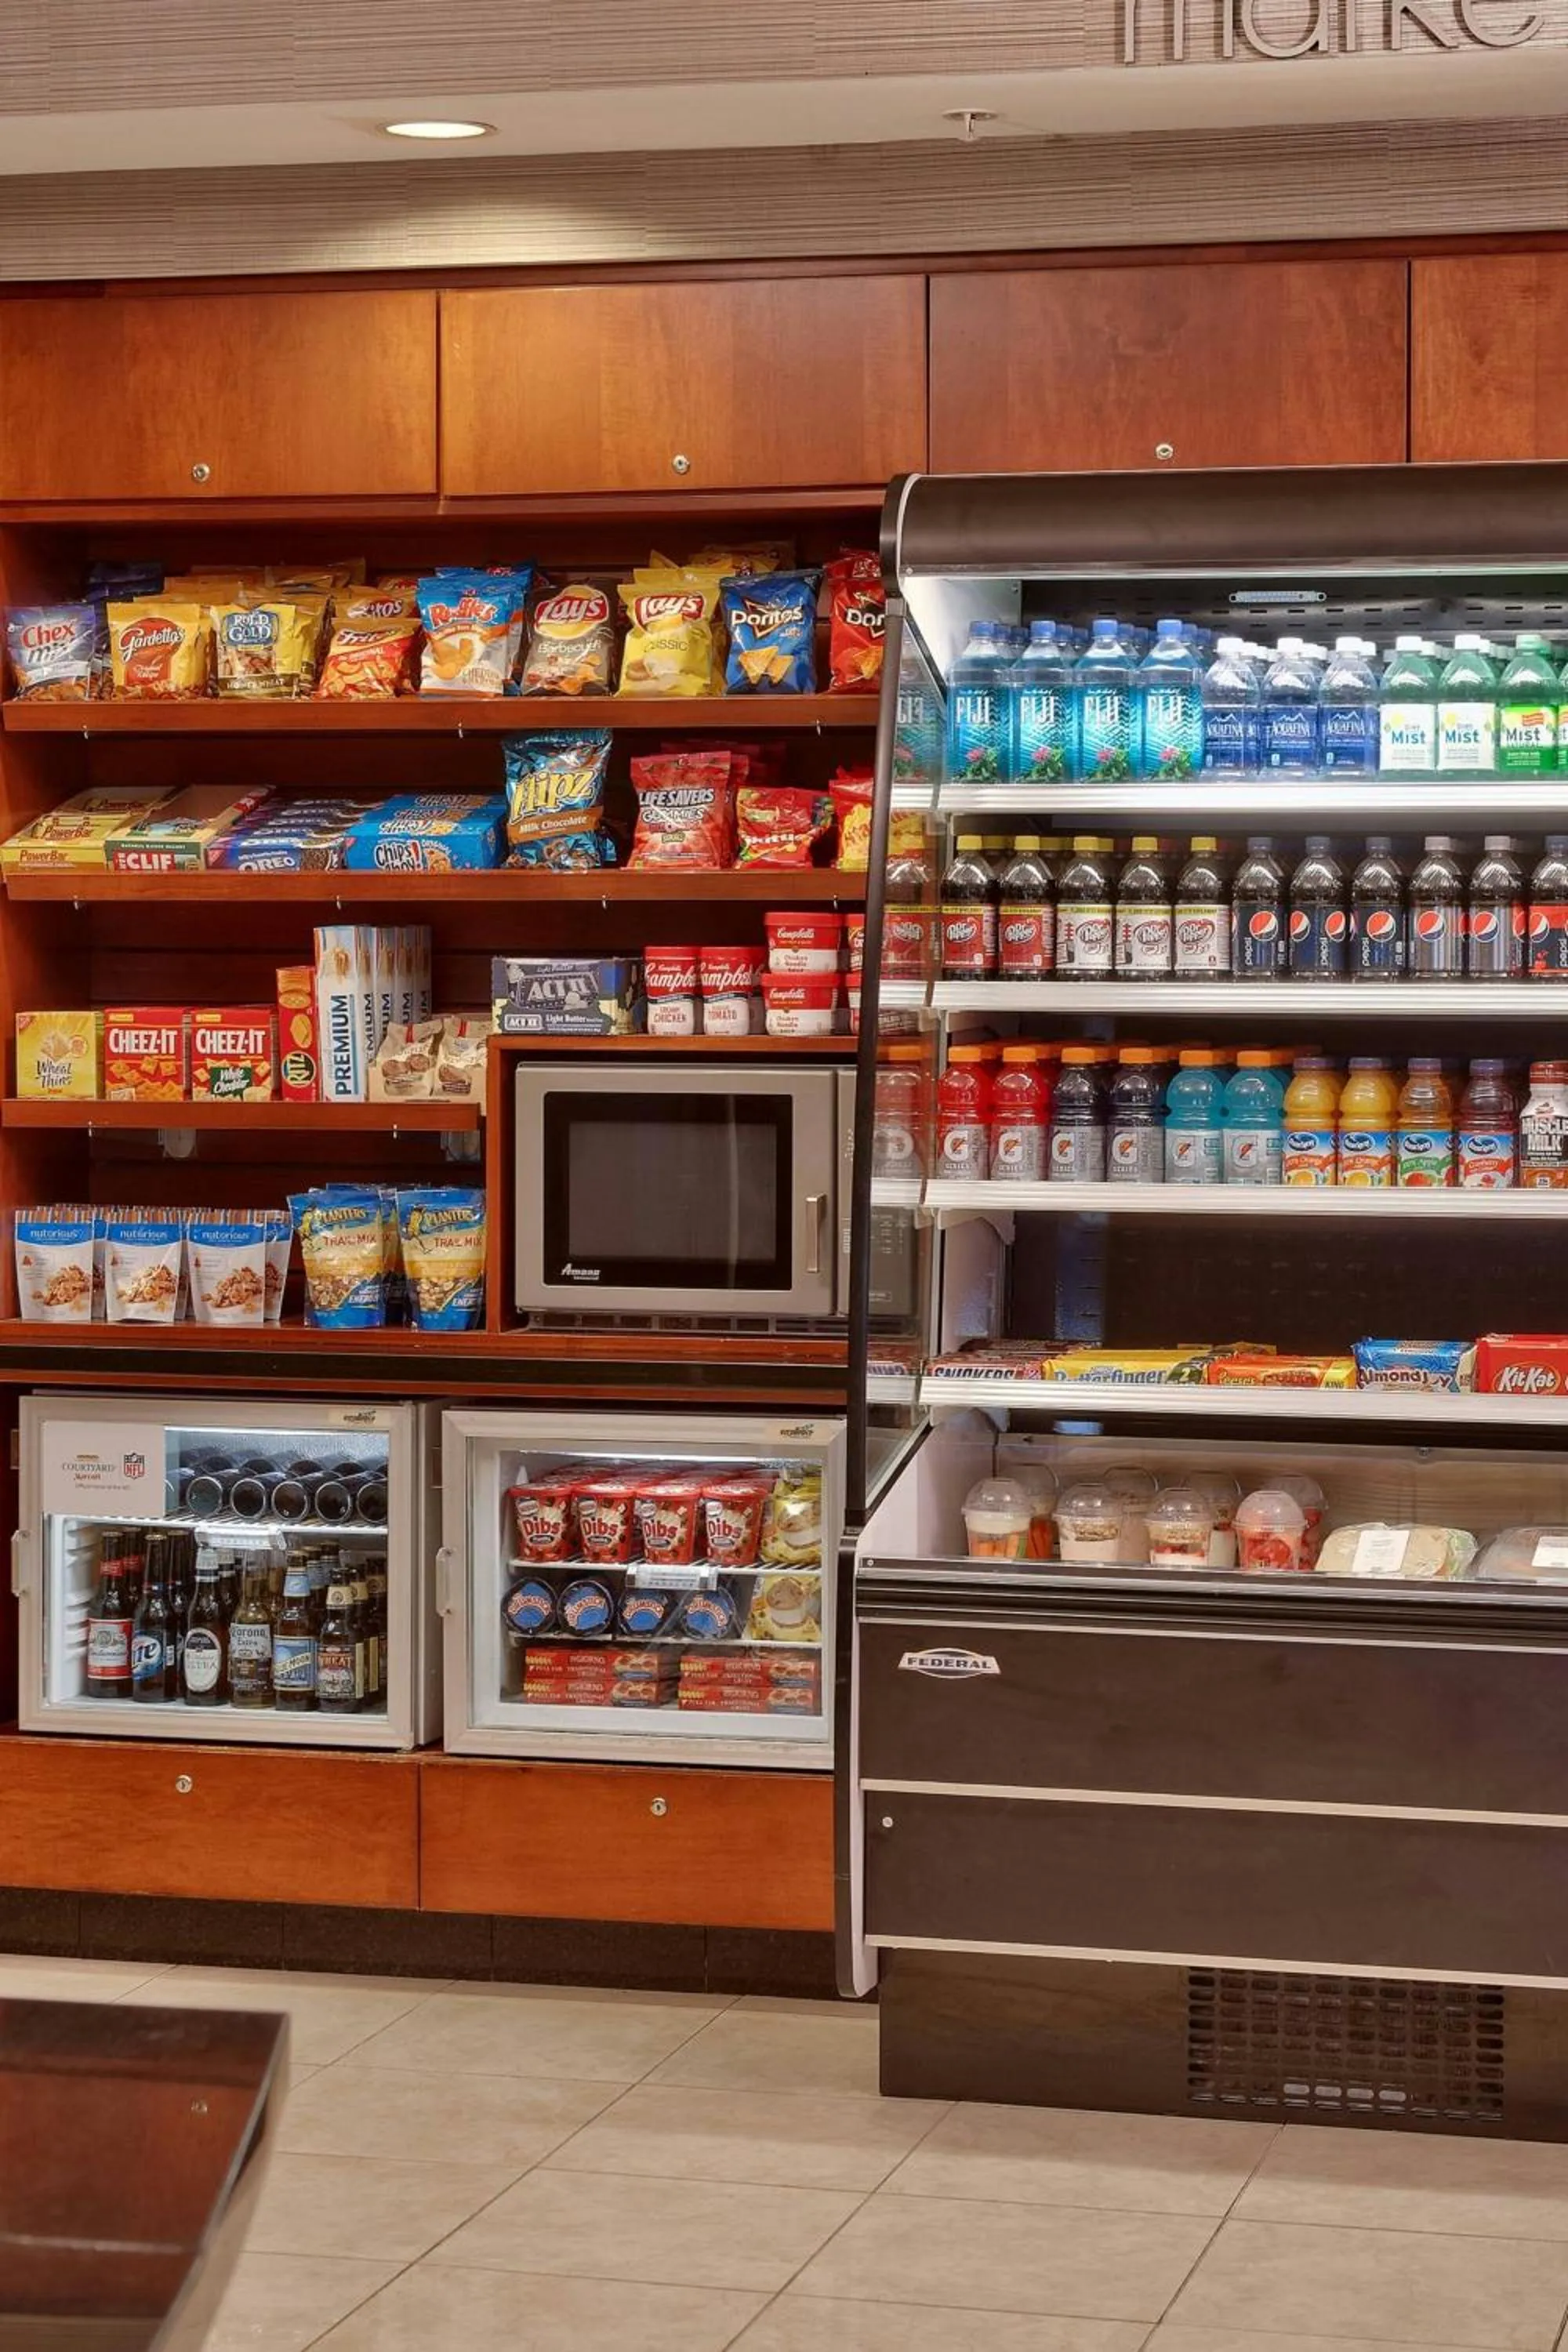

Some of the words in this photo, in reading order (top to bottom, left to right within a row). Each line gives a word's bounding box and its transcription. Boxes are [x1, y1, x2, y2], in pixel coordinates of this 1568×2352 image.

[731, 604, 804, 627] Doritos
[21, 619, 77, 649] Chex
[228, 625, 271, 643] GOLD
[955, 696, 991, 724] FIJI
[1020, 695, 1056, 724] FIJI
[1083, 695, 1120, 724] FIJI
[1146, 695, 1183, 724] FIJI
[1207, 721, 1243, 737] AQUAFINA
[1272, 721, 1310, 737] AQUAFINA
[1327, 718, 1365, 736] AQUAFINA
[1506, 727, 1541, 742] Mist
[1391, 729, 1427, 744] Mist
[1445, 729, 1480, 744] Mist
[639, 790, 667, 805] LIFE
[667, 787, 714, 807] SAVERS
[519, 822, 540, 835] Milk
[541, 816, 587, 832] Chocolate
[20, 849, 69, 862] PowerBar
[126, 853, 172, 870] CLIF
[238, 857, 295, 873] OREO
[1244, 937, 1254, 966] pepsi
[1319, 937, 1329, 966] pepsi
[1361, 937, 1370, 967] pepsi
[108, 1029, 178, 1054] CHEEZ-IT
[195, 1029, 266, 1055] CHEEZ-IT
[331, 995, 352, 1095] PREMIUM
[37, 1060, 72, 1076] Wheat
[287, 1053, 310, 1085] RITZ
[35, 1075, 73, 1088] Thins
[1522, 1116, 1568, 1135] MUSCLE
[1528, 1134, 1562, 1152] MILK
[356, 1233, 377, 1245] MIX
[464, 1235, 483, 1247] MIX
[561, 1262, 601, 1276] Amana
[1181, 1367, 1191, 1382] 2
[62, 1463, 116, 1472] COURTYARD
[125, 1463, 144, 1477] NFL
[521, 1517, 561, 1536] Dibs
[582, 1516, 619, 1537] Dibs
[643, 1516, 678, 1539] Dibs
[707, 1516, 741, 1538] Dibs
[906, 1656, 993, 1670] FEDERAL
